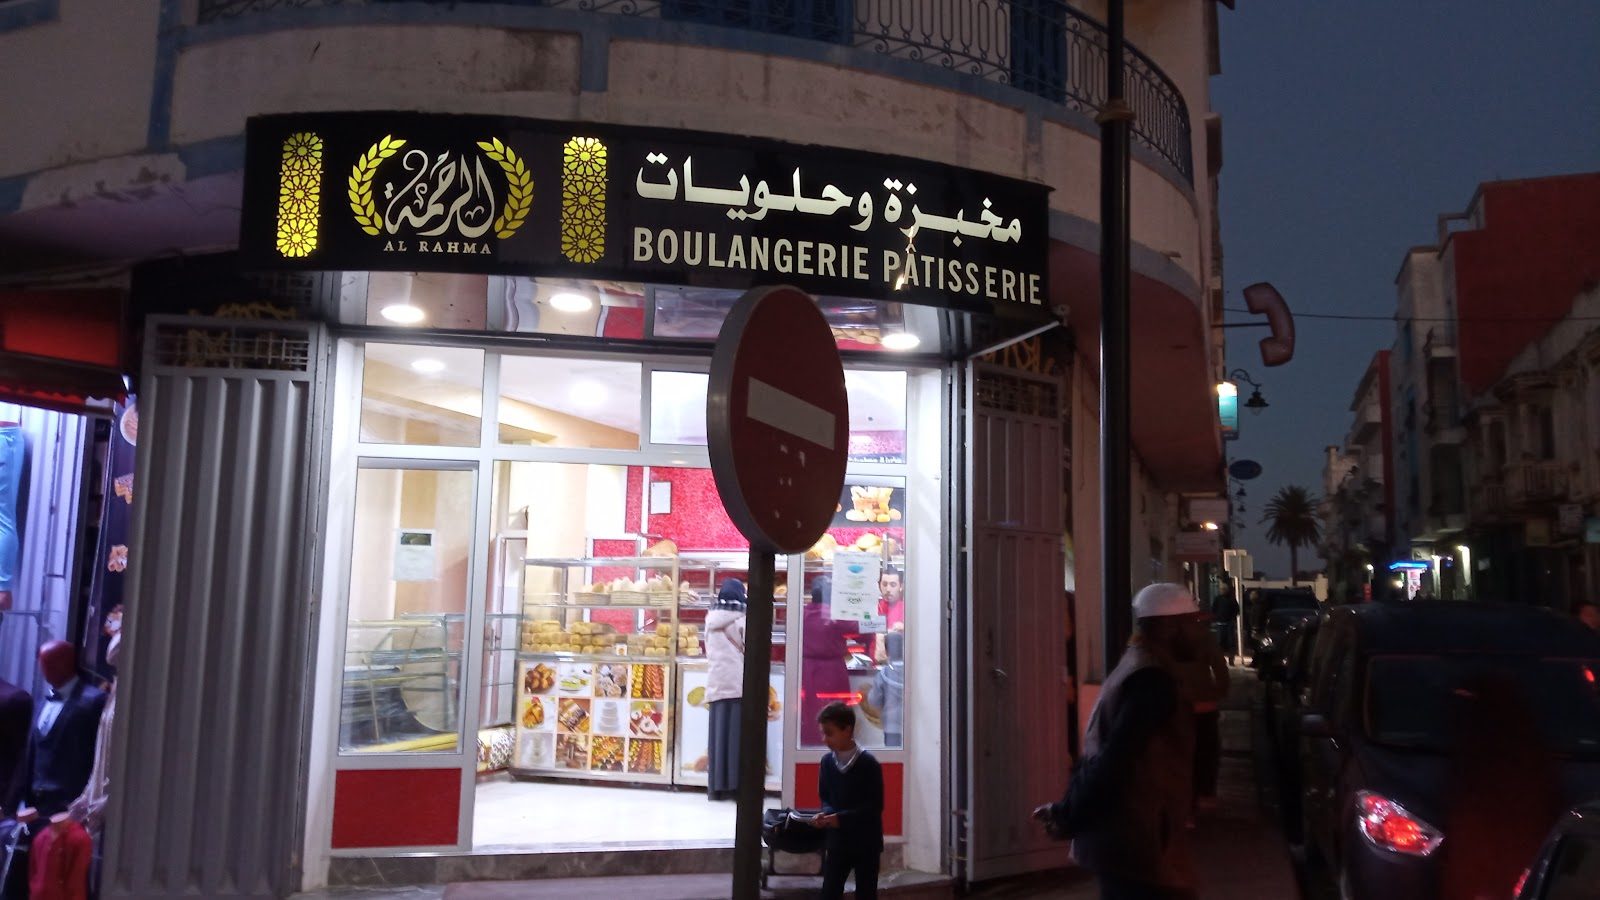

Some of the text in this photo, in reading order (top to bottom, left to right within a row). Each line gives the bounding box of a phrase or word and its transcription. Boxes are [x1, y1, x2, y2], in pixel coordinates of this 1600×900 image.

[636, 151, 1022, 247] مخبزة وحلويات
[383, 240, 492, 254] AL RAHMA
[633, 227, 1042, 305] BOULANGERIE PÂTISSERIE
